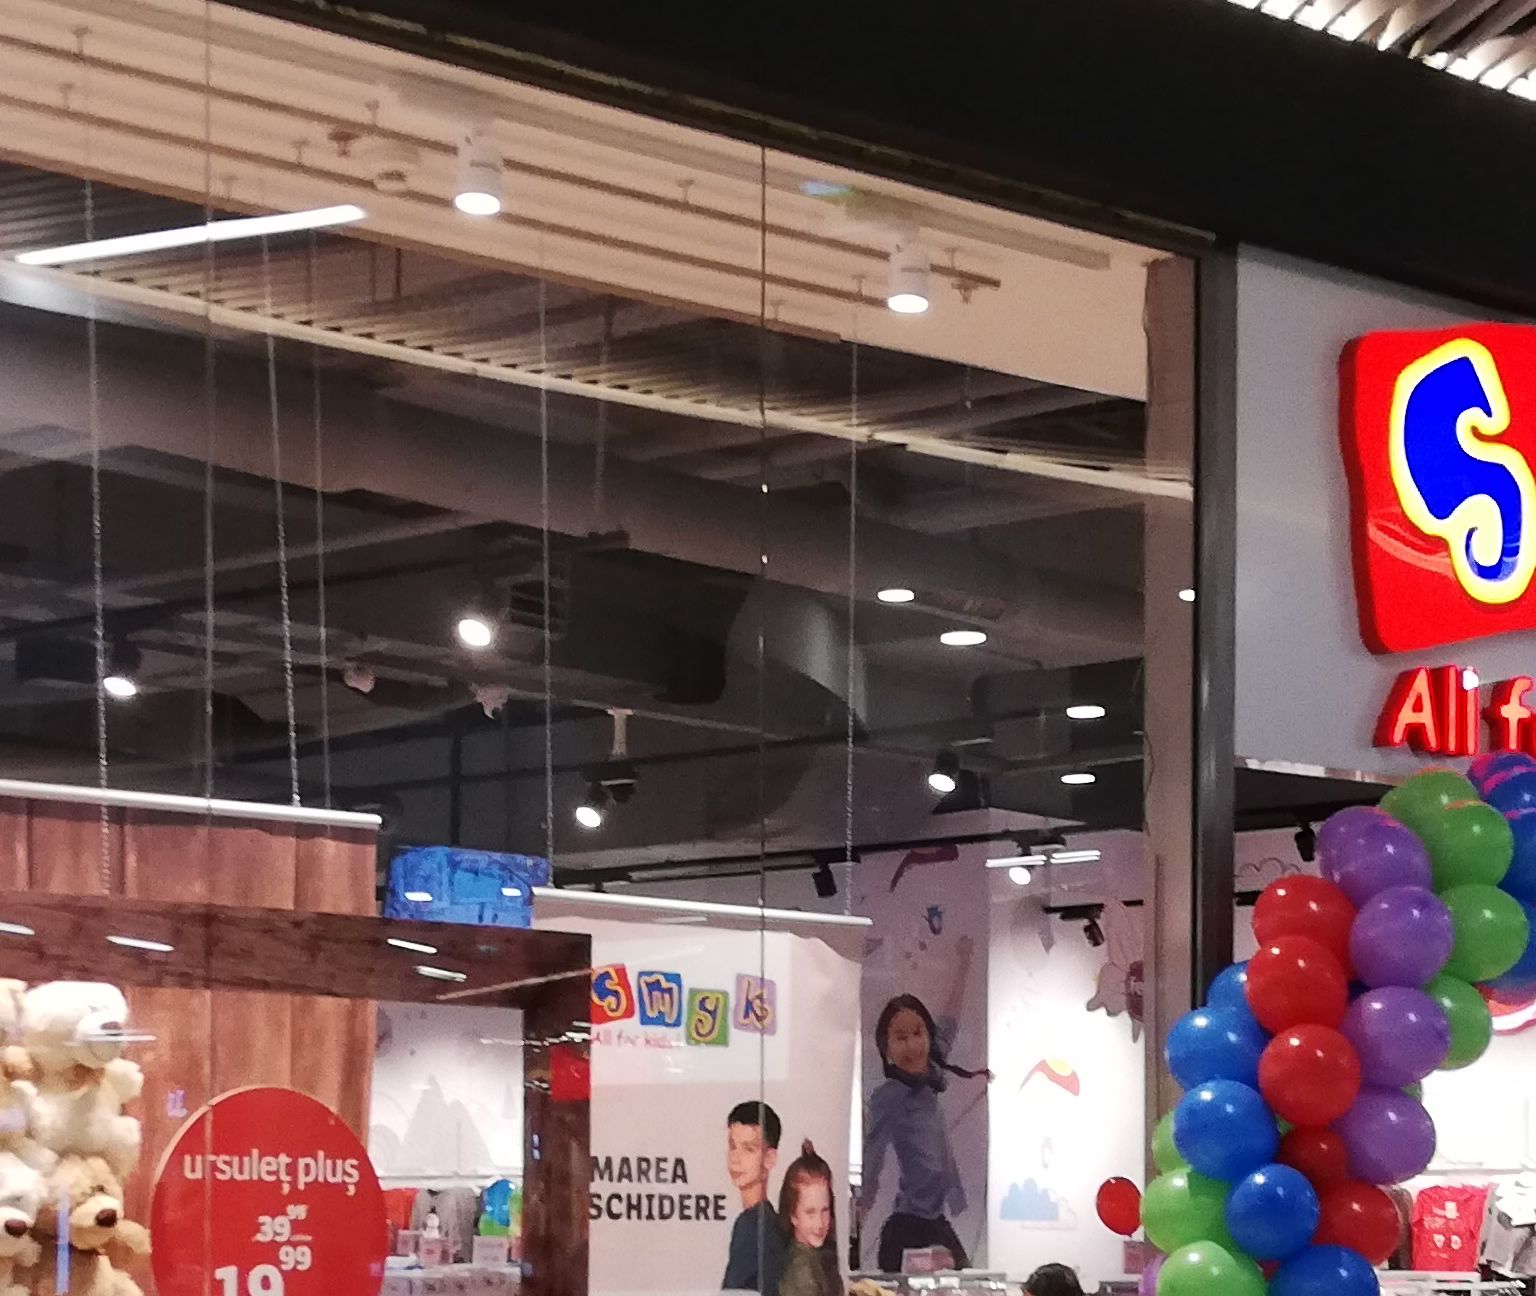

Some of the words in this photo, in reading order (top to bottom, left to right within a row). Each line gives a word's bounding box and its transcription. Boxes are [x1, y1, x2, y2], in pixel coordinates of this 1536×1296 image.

[1375, 664, 1480, 755] All
[590, 1156, 689, 1185] MAREA
[589, 1193, 728, 1222] SCHIDERE
[278, 1245, 312, 1271] 99
